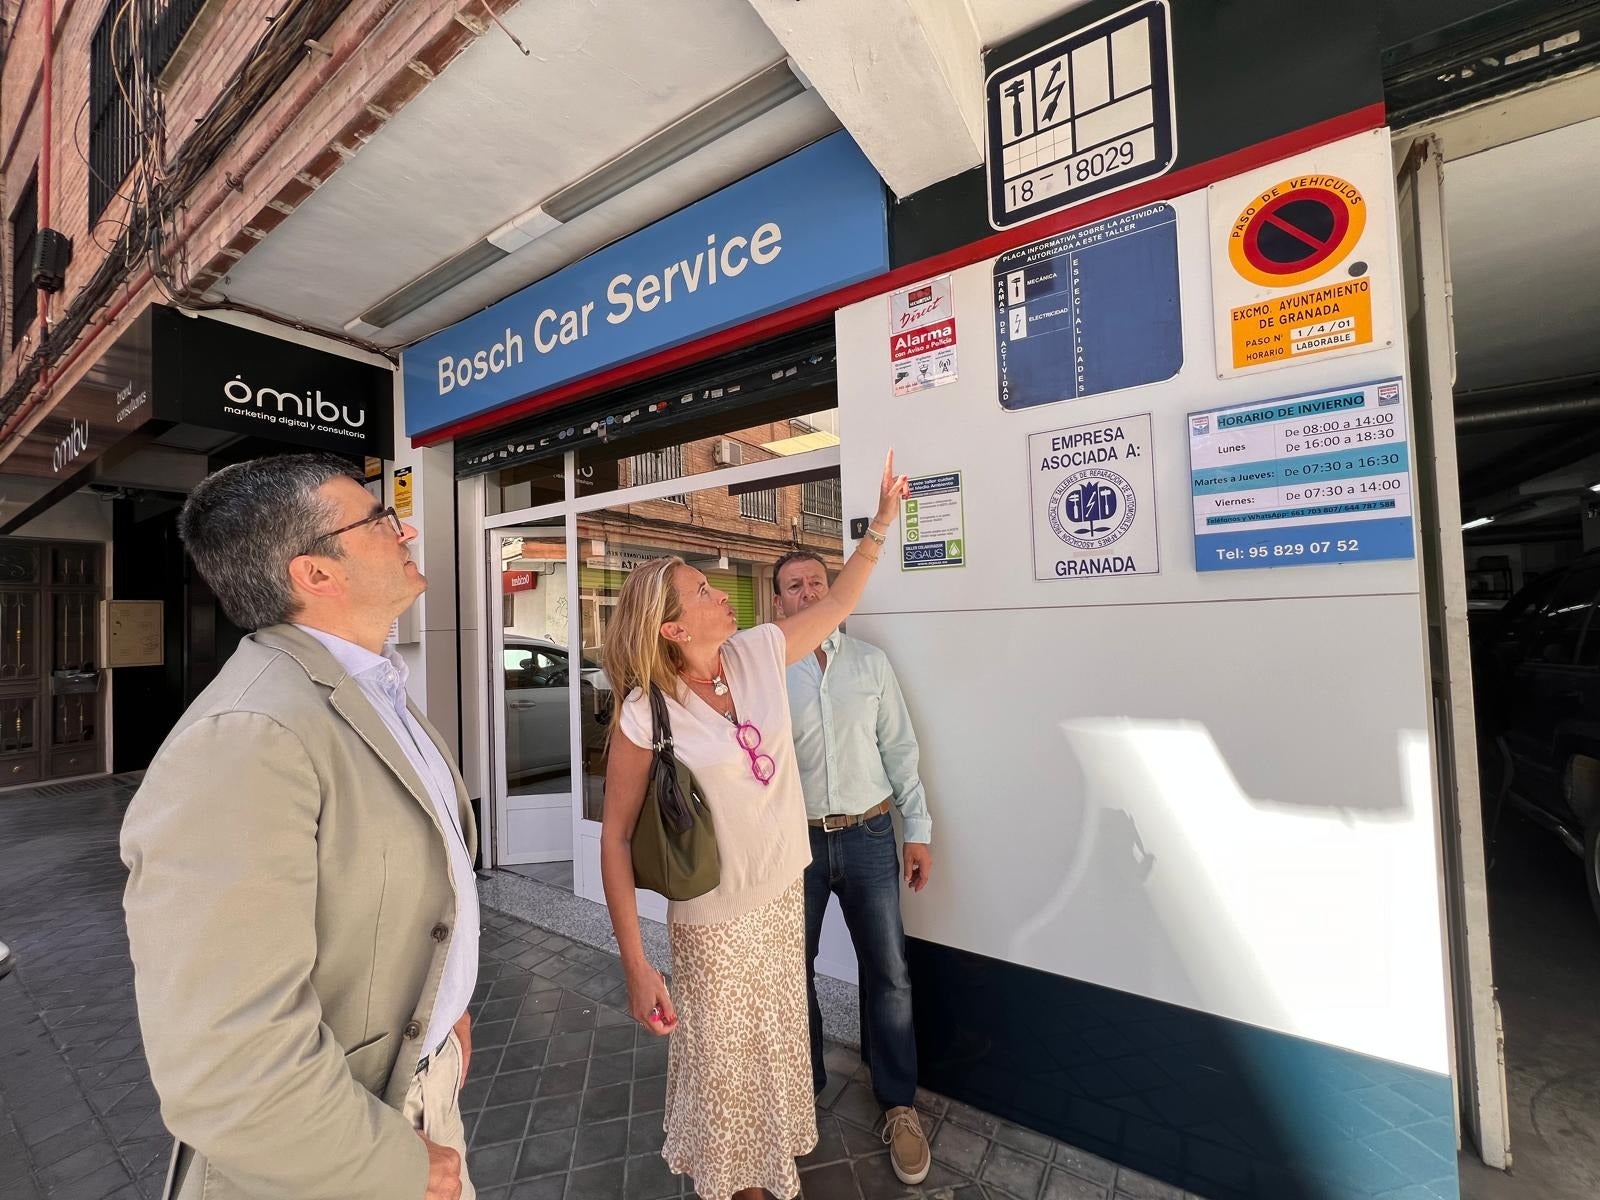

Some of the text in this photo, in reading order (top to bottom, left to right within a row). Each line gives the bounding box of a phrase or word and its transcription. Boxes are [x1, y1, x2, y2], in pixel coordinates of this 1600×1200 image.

[1010, 180, 1034, 206] 18
[1064, 141, 1134, 186] 18029
[1232, 177, 1362, 238] PASO DE VEHICULOS
[1002, 205, 1165, 263] PLACA INFORMATIVA SOBRE LA ACTIVIDAD
[1027, 244, 1074, 263] AUTORIZADA
[1083, 233, 1102, 245] ESTE
[1105, 223, 1136, 238] TALLER
[1279, 281, 1369, 312] AYUNTAMIENTO
[438, 222, 782, 396] Bosch Car Service
[900, 296, 944, 329] Direct
[1028, 307, 1068, 322] ELECTRICIDAD
[1259, 303, 1340, 329] DE GRANADA
[1000, 321, 1006, 334] DE
[1073, 259, 1085, 392] ESPECIALIDADES
[895, 326, 952, 351] Alarma
[907, 344, 924, 355] Aviso
[1245, 336, 1271, 347] PASO
[1296, 334, 1351, 351] LABORABLE
[1246, 347, 1284, 361] HORARIO
[223, 405, 276, 423] marketing
[278, 416, 309, 429] digital
[1218, 410, 1274, 428] HORARIO
[1278, 407, 1294, 418] DE
[1298, 395, 1365, 415] INVIERNO
[1285, 428, 1300, 438] De
[1303, 421, 1339, 435] 08:00
[1356, 412, 1394, 427] 14:00
[1052, 426, 1125, 452] EMPRESA
[1218, 443, 1246, 454] Lunes
[1286, 428, 1394, 452] De 16:00 a 18:30
[1041, 443, 1141, 471] ASOCIADA A:
[1285, 453, 1399, 477] De 07:30 a 16:30
[1056, 475, 1078, 496] TALLERES
[1080, 471, 1087, 479] DE
[1121, 484, 1130, 492] DE
[1194, 476, 1228, 487] Martes
[1239, 470, 1275, 482] Jueves:
[1286, 479, 1401, 501] De 07:30 a 14:00
[1206, 516, 1241, 525] Teléfonos
[1247, 512, 1289, 521] WhatsApp:
[1291, 508, 1305, 517] 661
[1307, 507, 1321, 515] 703
[1323, 504, 1341, 513] 807/
[1345, 503, 1359, 511] 644
[1361, 502, 1377, 510] 787
[1215, 497, 1255, 507] Viernes:
[905, 548, 944, 560] SIGAUS
[1216, 539, 1359, 560] Tel: 95 829 07 52
[1055, 556, 1136, 577] GRANADA
